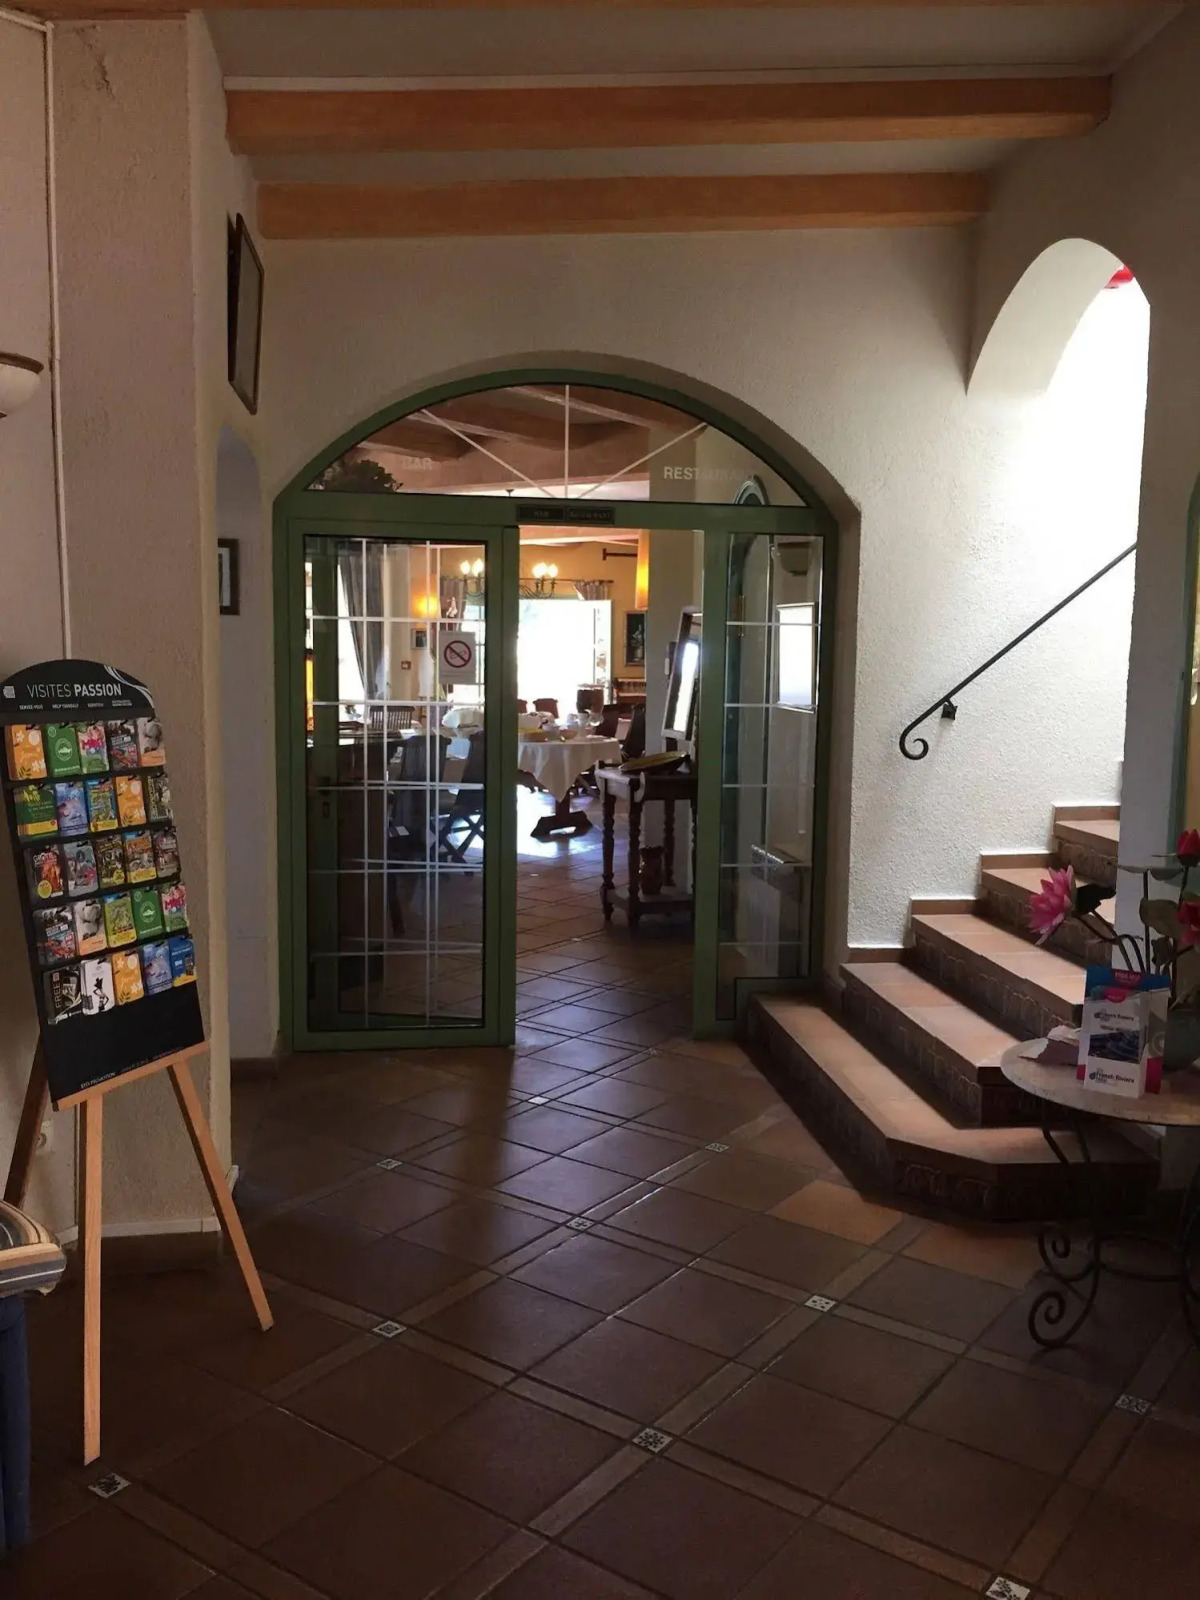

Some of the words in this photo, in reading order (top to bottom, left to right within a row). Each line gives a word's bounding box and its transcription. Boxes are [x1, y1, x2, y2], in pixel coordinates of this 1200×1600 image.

[403, 457, 432, 471] BAR
[27, 684, 72, 699] VISITES
[73, 683, 122, 697] PASSION
[53, 982, 62, 1009] FREE
[1115, 1074, 1135, 1084] Riviera
